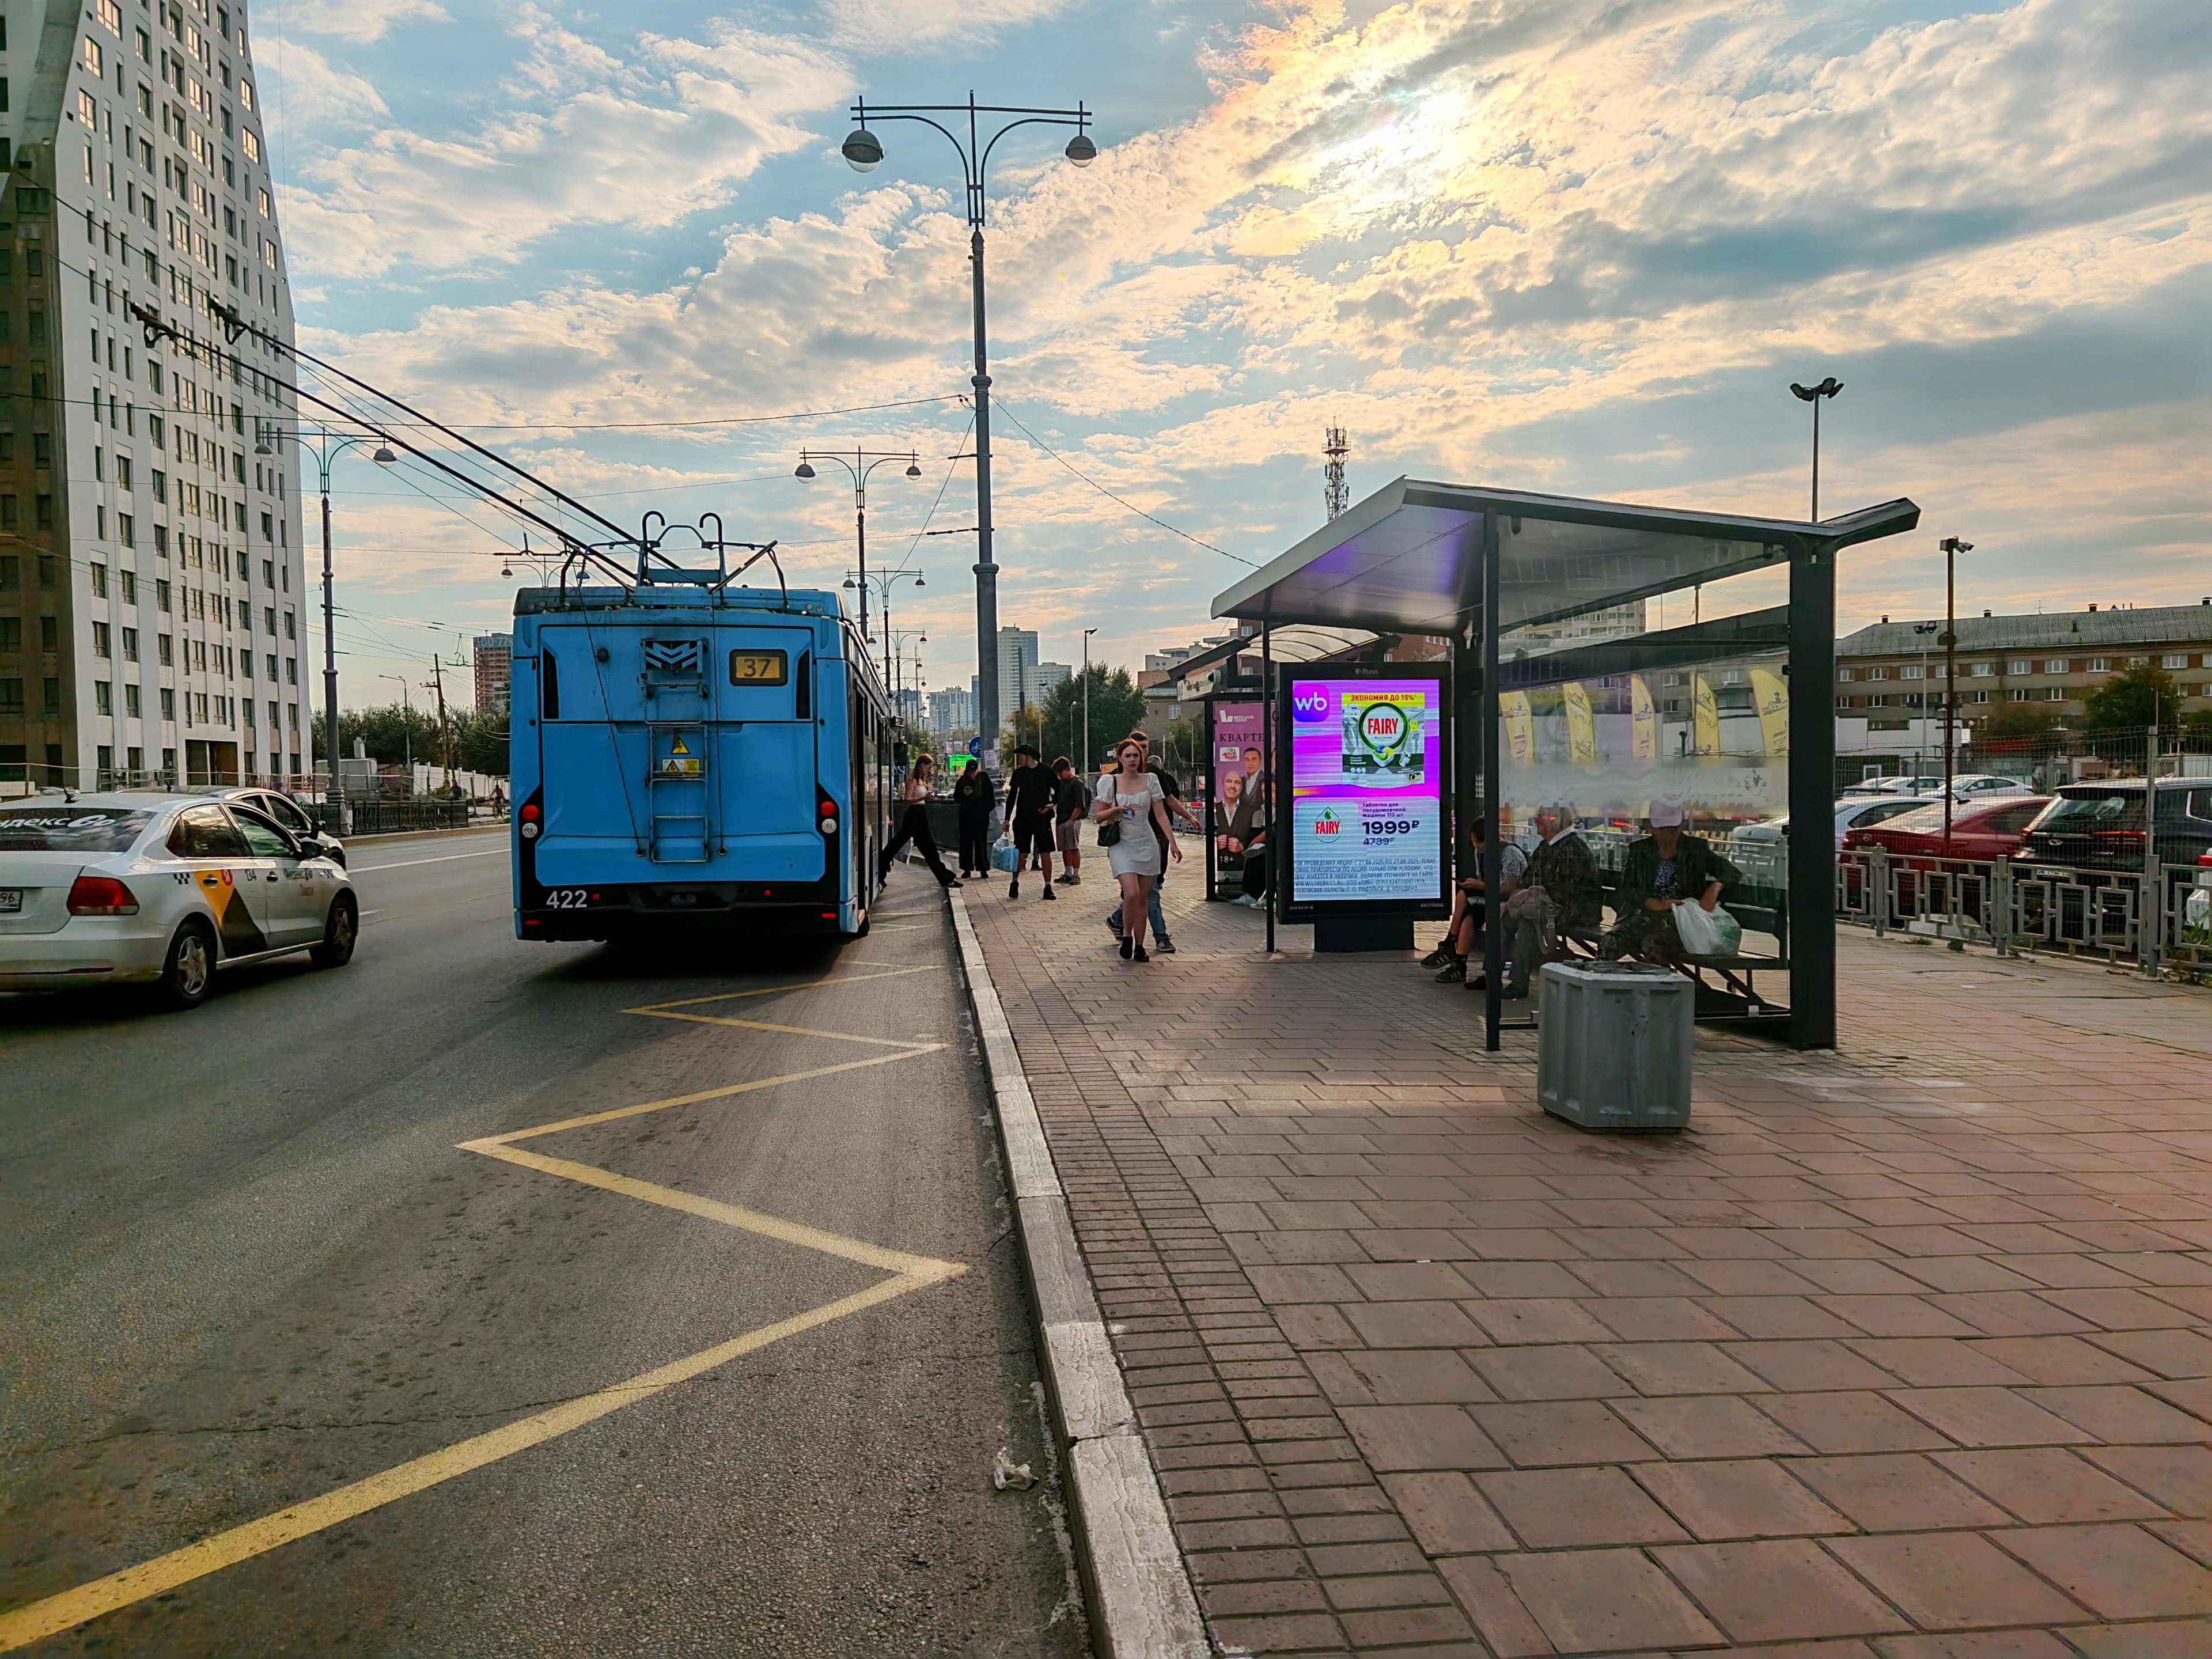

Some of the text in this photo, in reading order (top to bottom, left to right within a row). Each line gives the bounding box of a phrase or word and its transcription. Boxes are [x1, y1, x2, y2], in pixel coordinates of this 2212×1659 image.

[744, 658, 771, 677] 37
[1294, 691, 1328, 711] wb
[1368, 718, 1399, 734] FAIRY
[1315, 821, 1340, 834] FAIRY
[546, 889, 588, 909] 422
